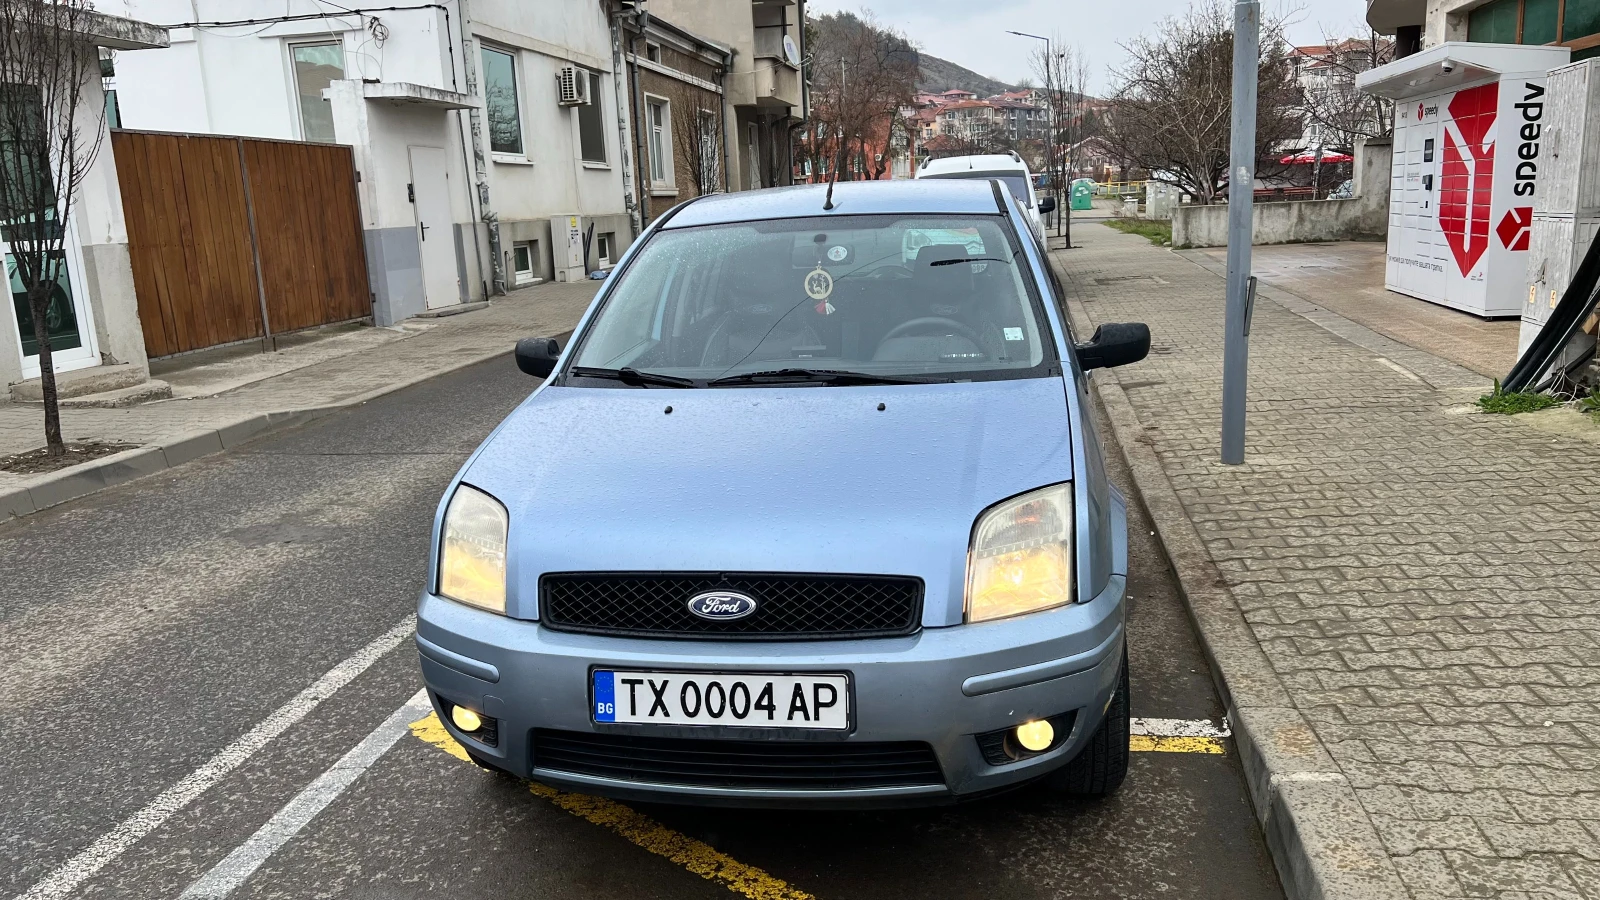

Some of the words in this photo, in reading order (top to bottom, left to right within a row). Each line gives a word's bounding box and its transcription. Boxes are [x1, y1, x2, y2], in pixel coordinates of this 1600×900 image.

[1424, 103, 1439, 119] speedy
[1513, 82, 1545, 197] speedy
[702, 597, 740, 614] Ford
[597, 702, 614, 714] BG
[621, 678, 671, 717] TX
[680, 680, 776, 721] 0004
[787, 682, 838, 721] AP
